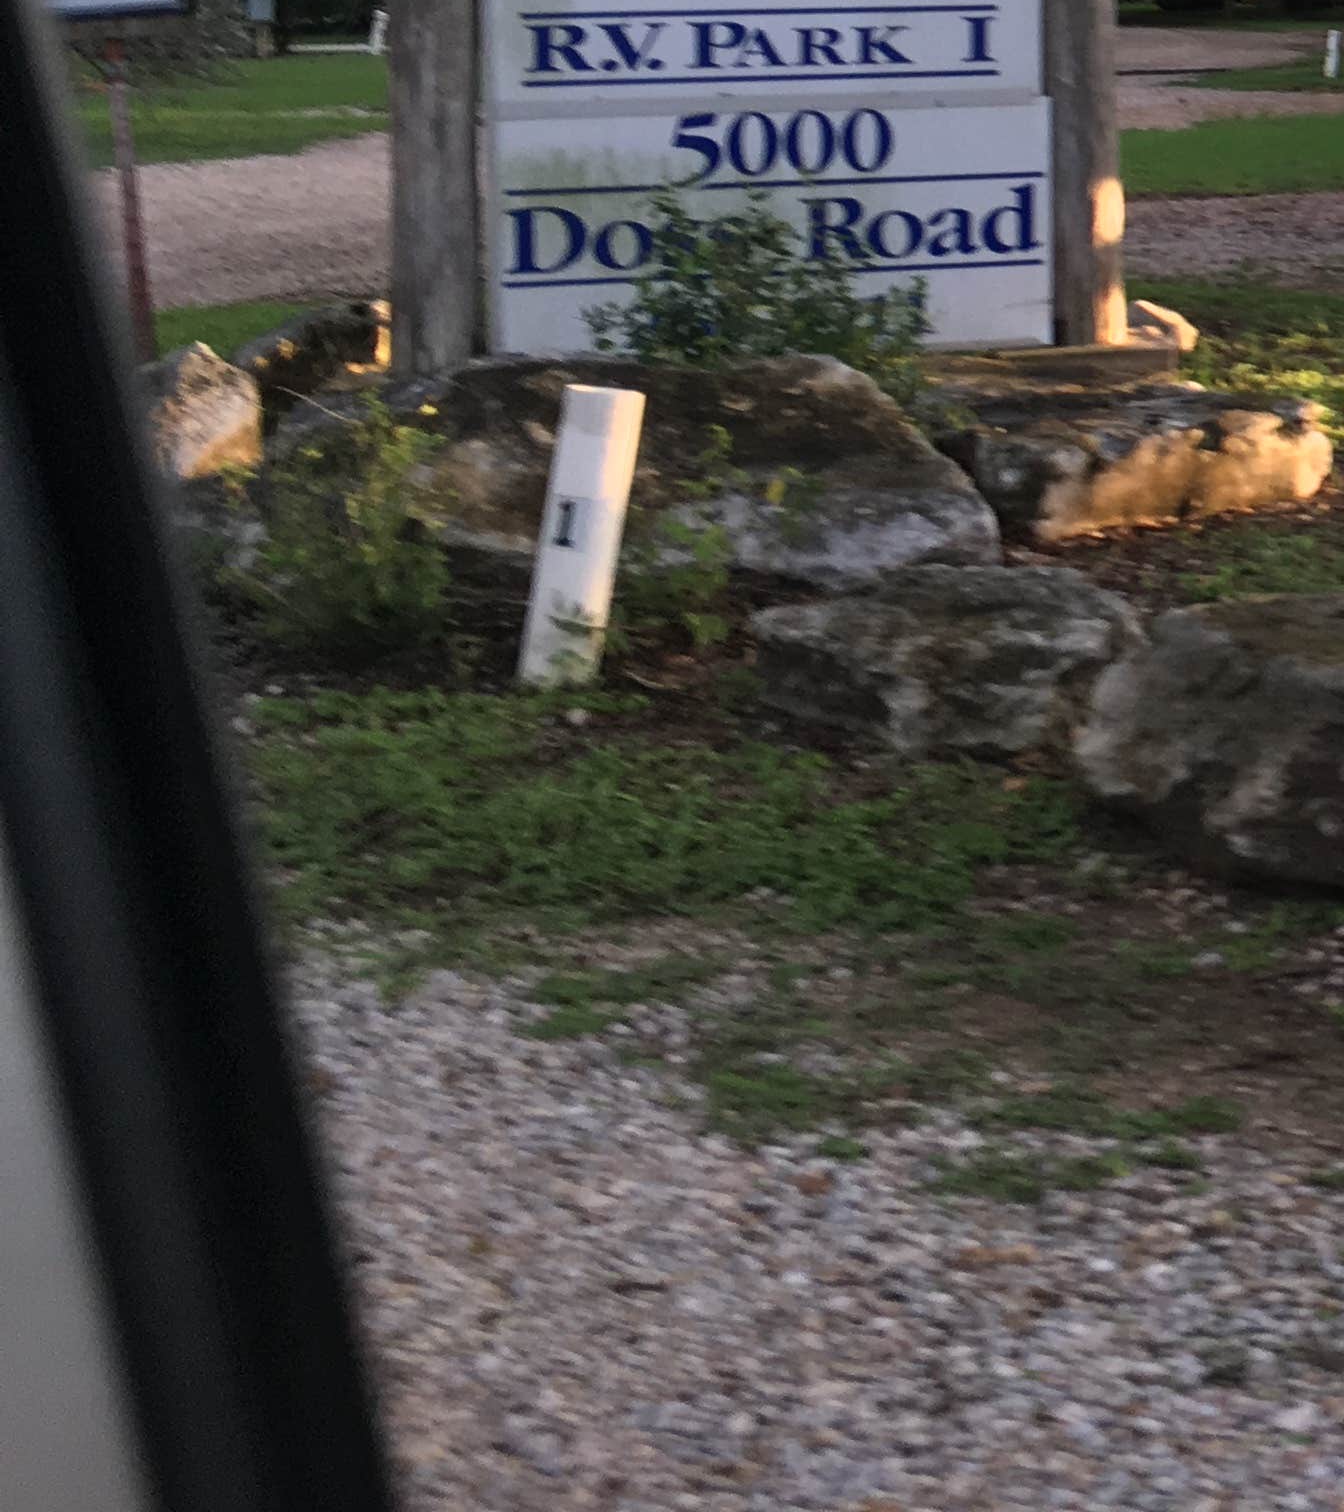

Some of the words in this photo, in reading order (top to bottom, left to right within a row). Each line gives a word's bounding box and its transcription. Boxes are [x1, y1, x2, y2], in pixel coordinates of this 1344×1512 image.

[524, 22, 666, 73] R.V.
[686, 20, 914, 70] PARK
[671, 107, 895, 183] 5000
[797, 184, 1044, 263] Road
